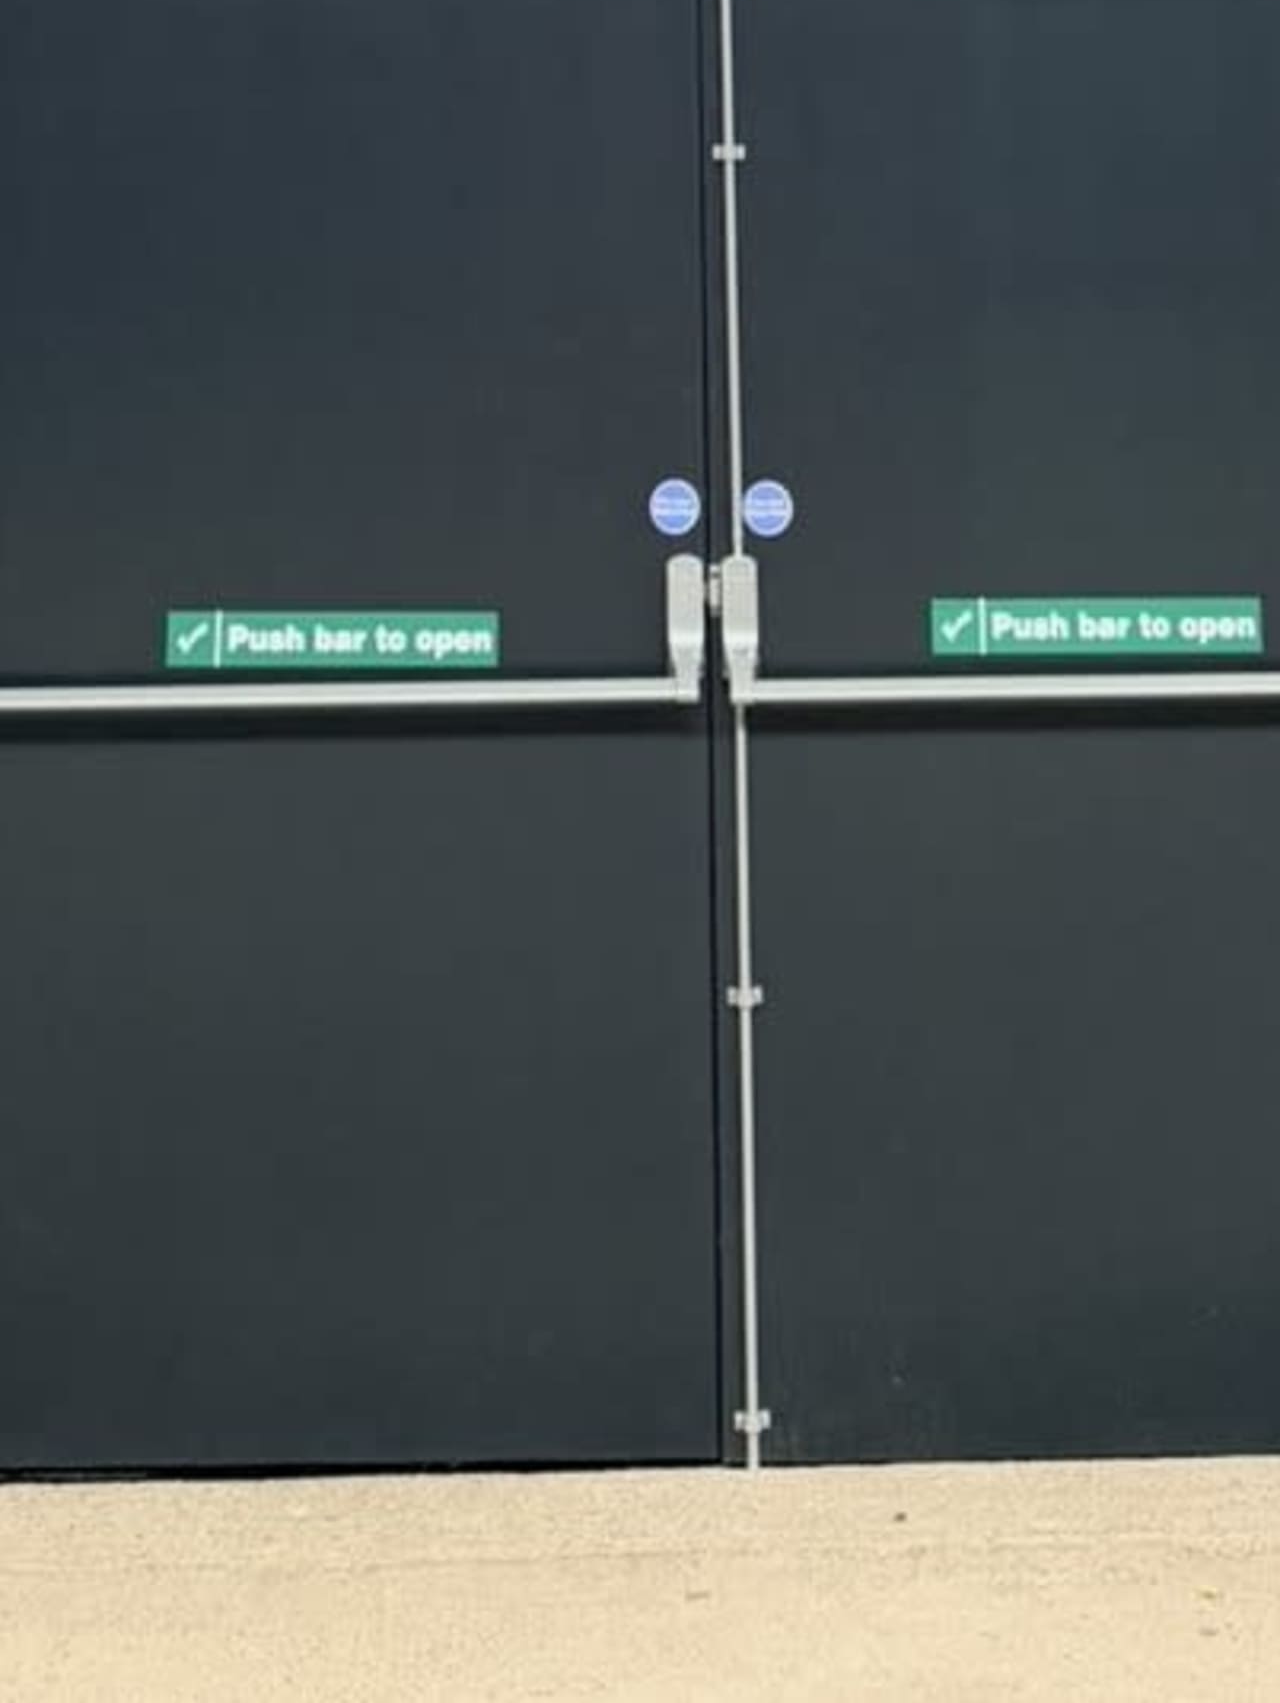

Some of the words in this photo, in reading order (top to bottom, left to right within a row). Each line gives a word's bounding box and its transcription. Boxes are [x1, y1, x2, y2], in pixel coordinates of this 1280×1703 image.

[227, 623, 307, 653] Push
[313, 623, 367, 653] bar
[375, 625, 406, 653] to
[414, 629, 493, 660] open
[990, 611, 1070, 640] Push
[1077, 610, 1132, 640] bar
[1138, 612, 1170, 639] to
[1178, 616, 1257, 644] open
